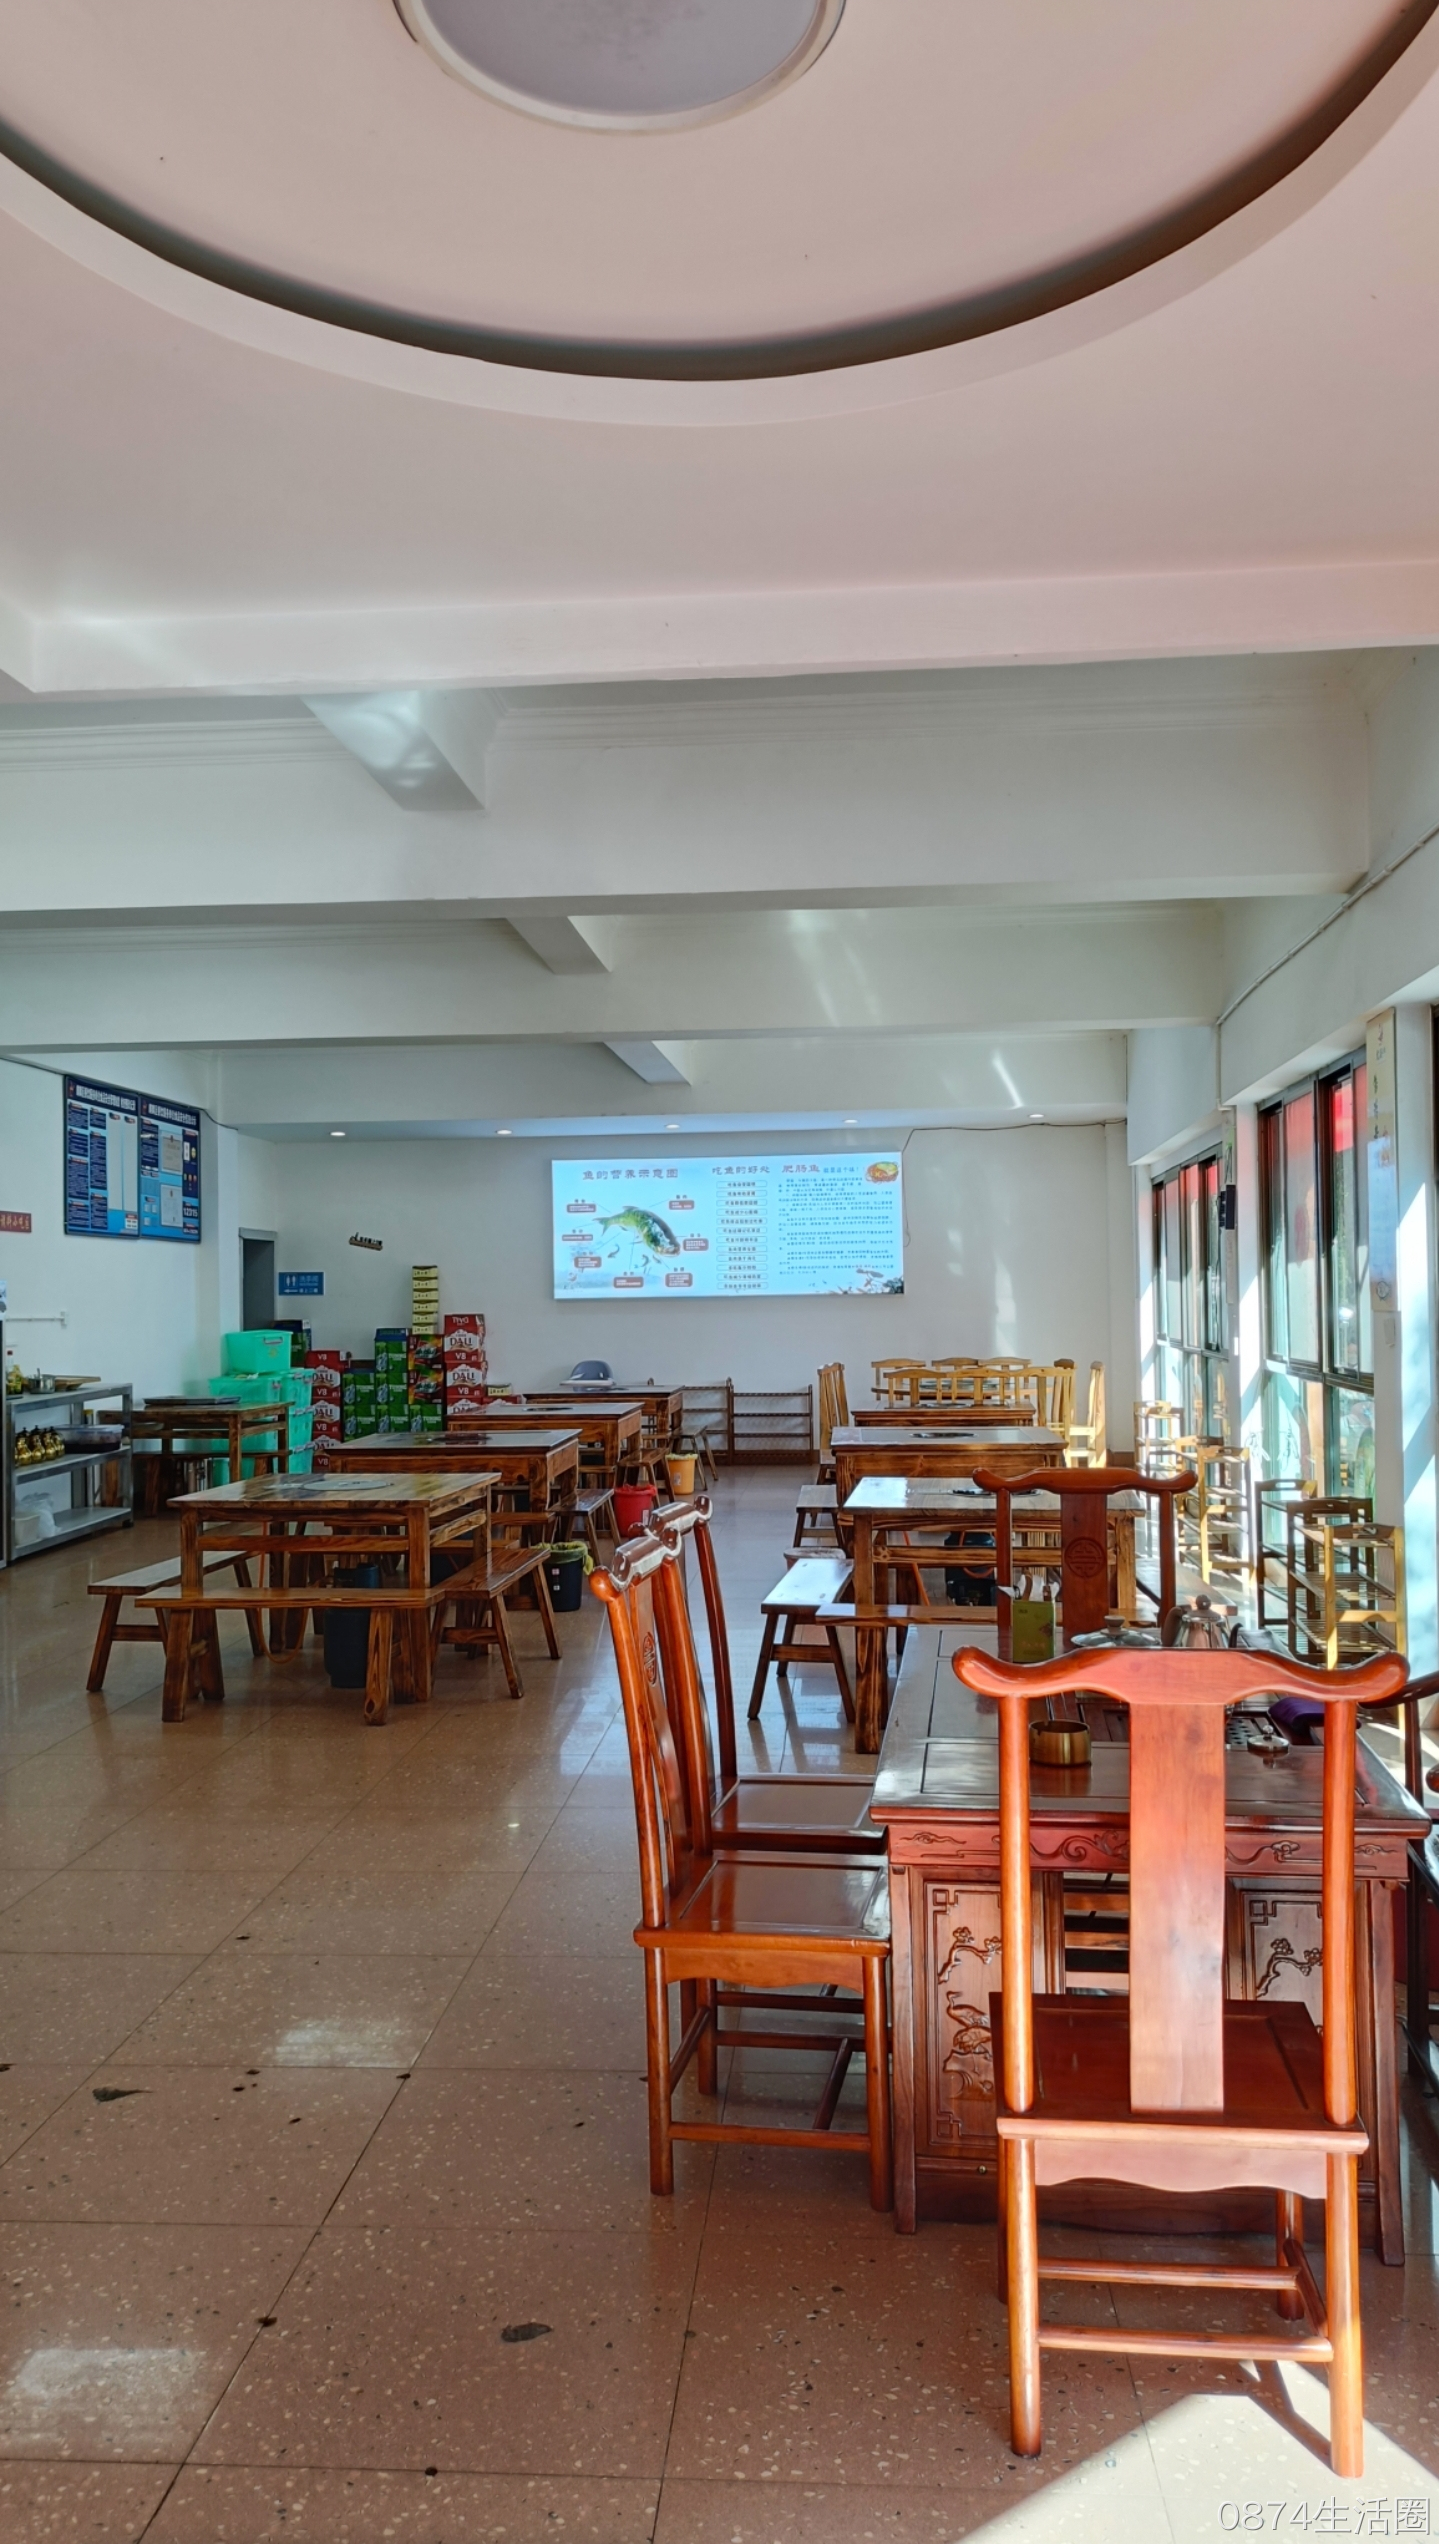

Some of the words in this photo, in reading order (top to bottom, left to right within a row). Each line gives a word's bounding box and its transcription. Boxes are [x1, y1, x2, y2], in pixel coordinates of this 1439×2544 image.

[711, 1165, 771, 1175] 吃鱼的好处
[781, 1164, 820, 1174] 肥肠鱼
[583, 1168, 679, 1181] 鱼的营养示意图
